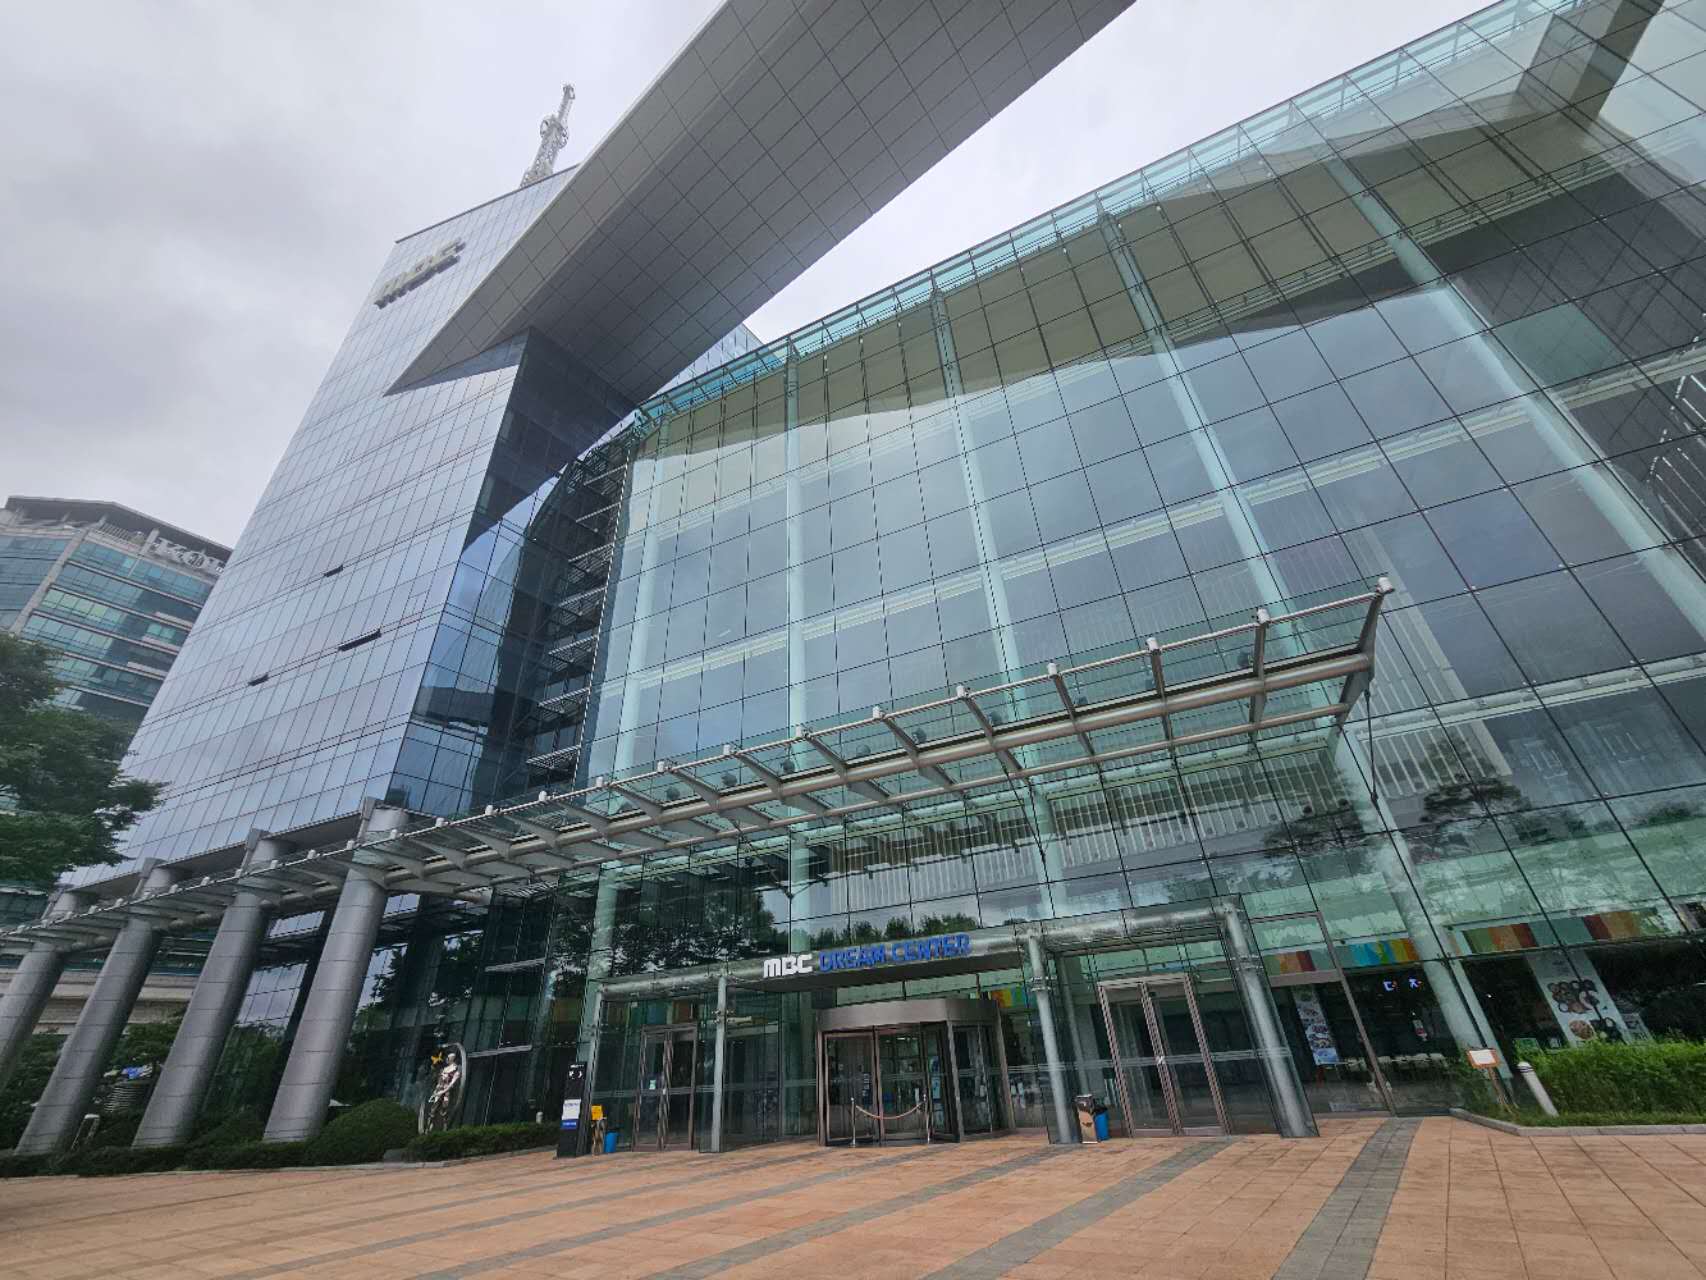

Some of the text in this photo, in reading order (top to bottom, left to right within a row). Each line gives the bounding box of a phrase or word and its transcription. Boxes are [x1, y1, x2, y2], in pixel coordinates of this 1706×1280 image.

[763, 934, 972, 979] MBC DREAM CENTER
